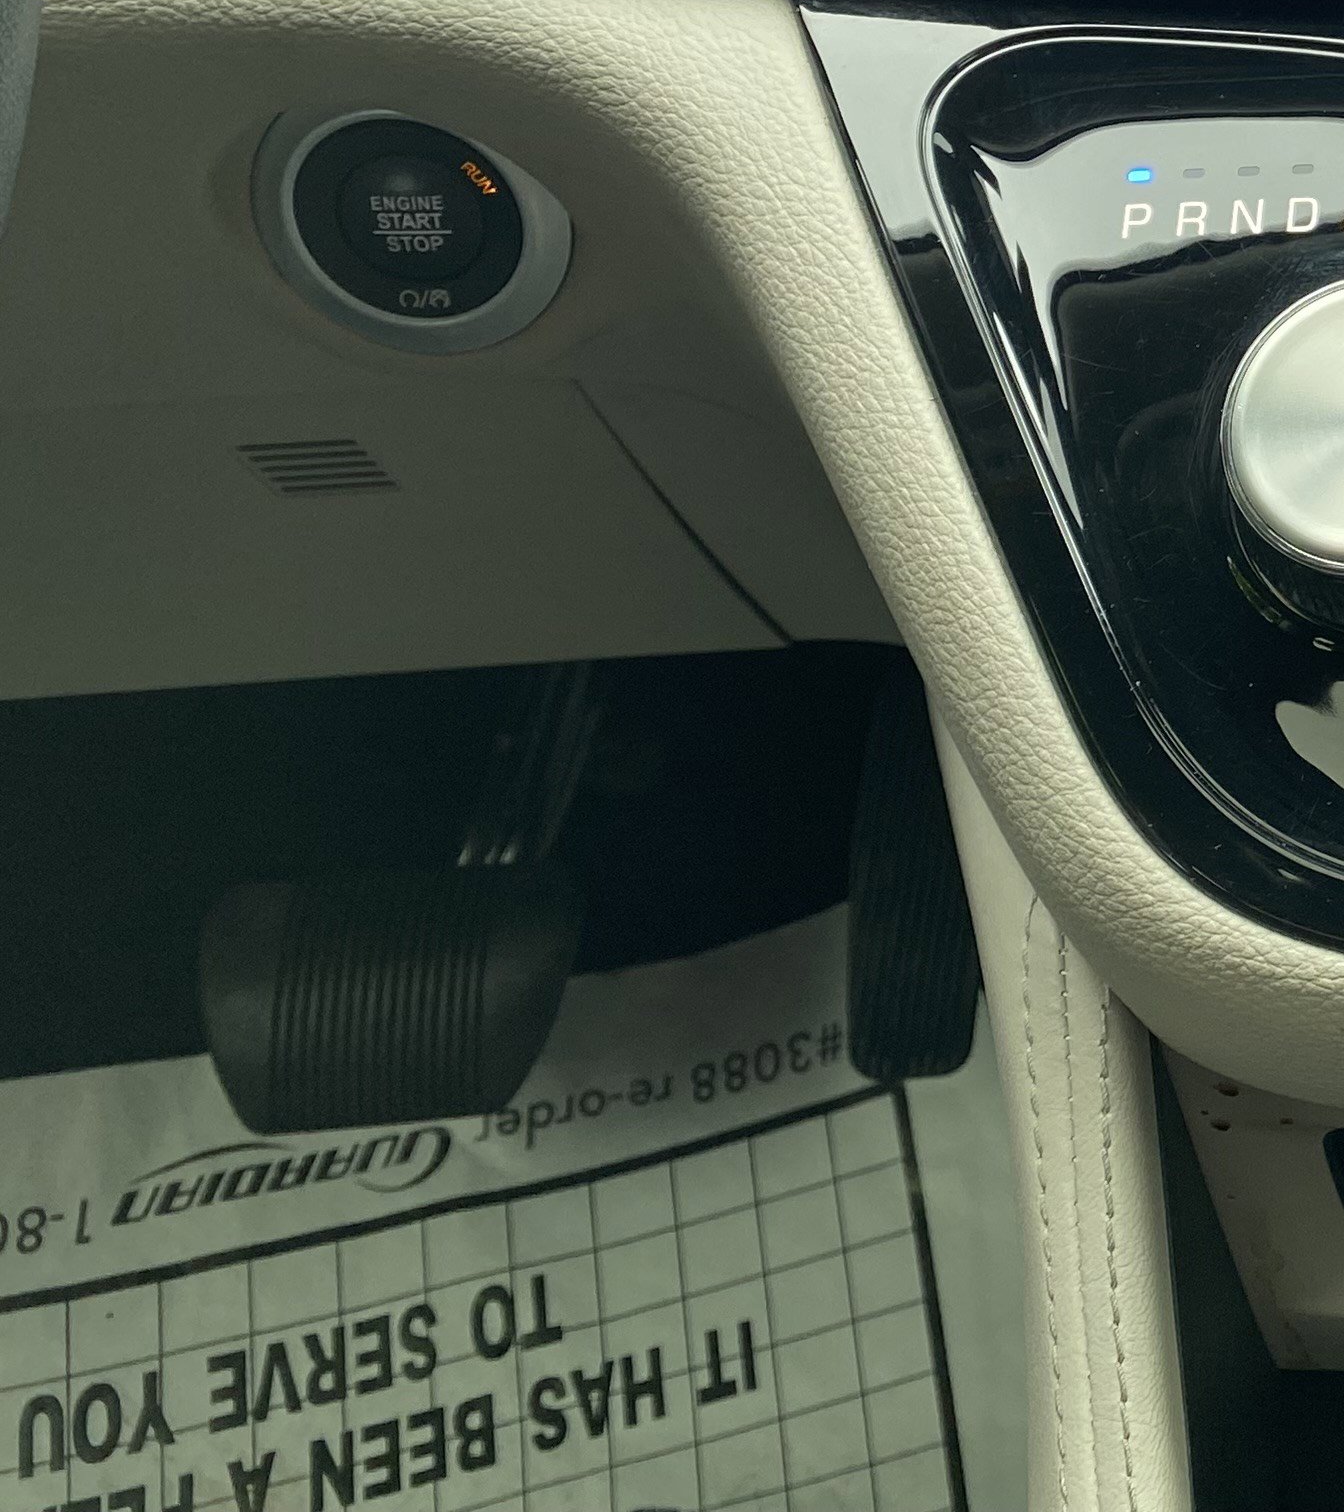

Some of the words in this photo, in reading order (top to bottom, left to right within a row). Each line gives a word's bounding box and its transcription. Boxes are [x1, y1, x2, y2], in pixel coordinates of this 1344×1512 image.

[370, 195, 444, 211] ENGINE
[461, 161, 498, 195] RUN
[377, 213, 441, 229] START
[386, 236, 444, 252] STOP
[690, 1023, 844, 1105] #3088
[0, 1197, 92, 1254] 1-8
[469, 1273, 563, 1362] TO
[207, 1303, 437, 1434] SERVE
[527, 1346, 666, 1452] HAS
[696, 1320, 757, 1407] IT
[18, 1370, 175, 1480] YOU
[308, 1393, 495, 1512] BEEN
